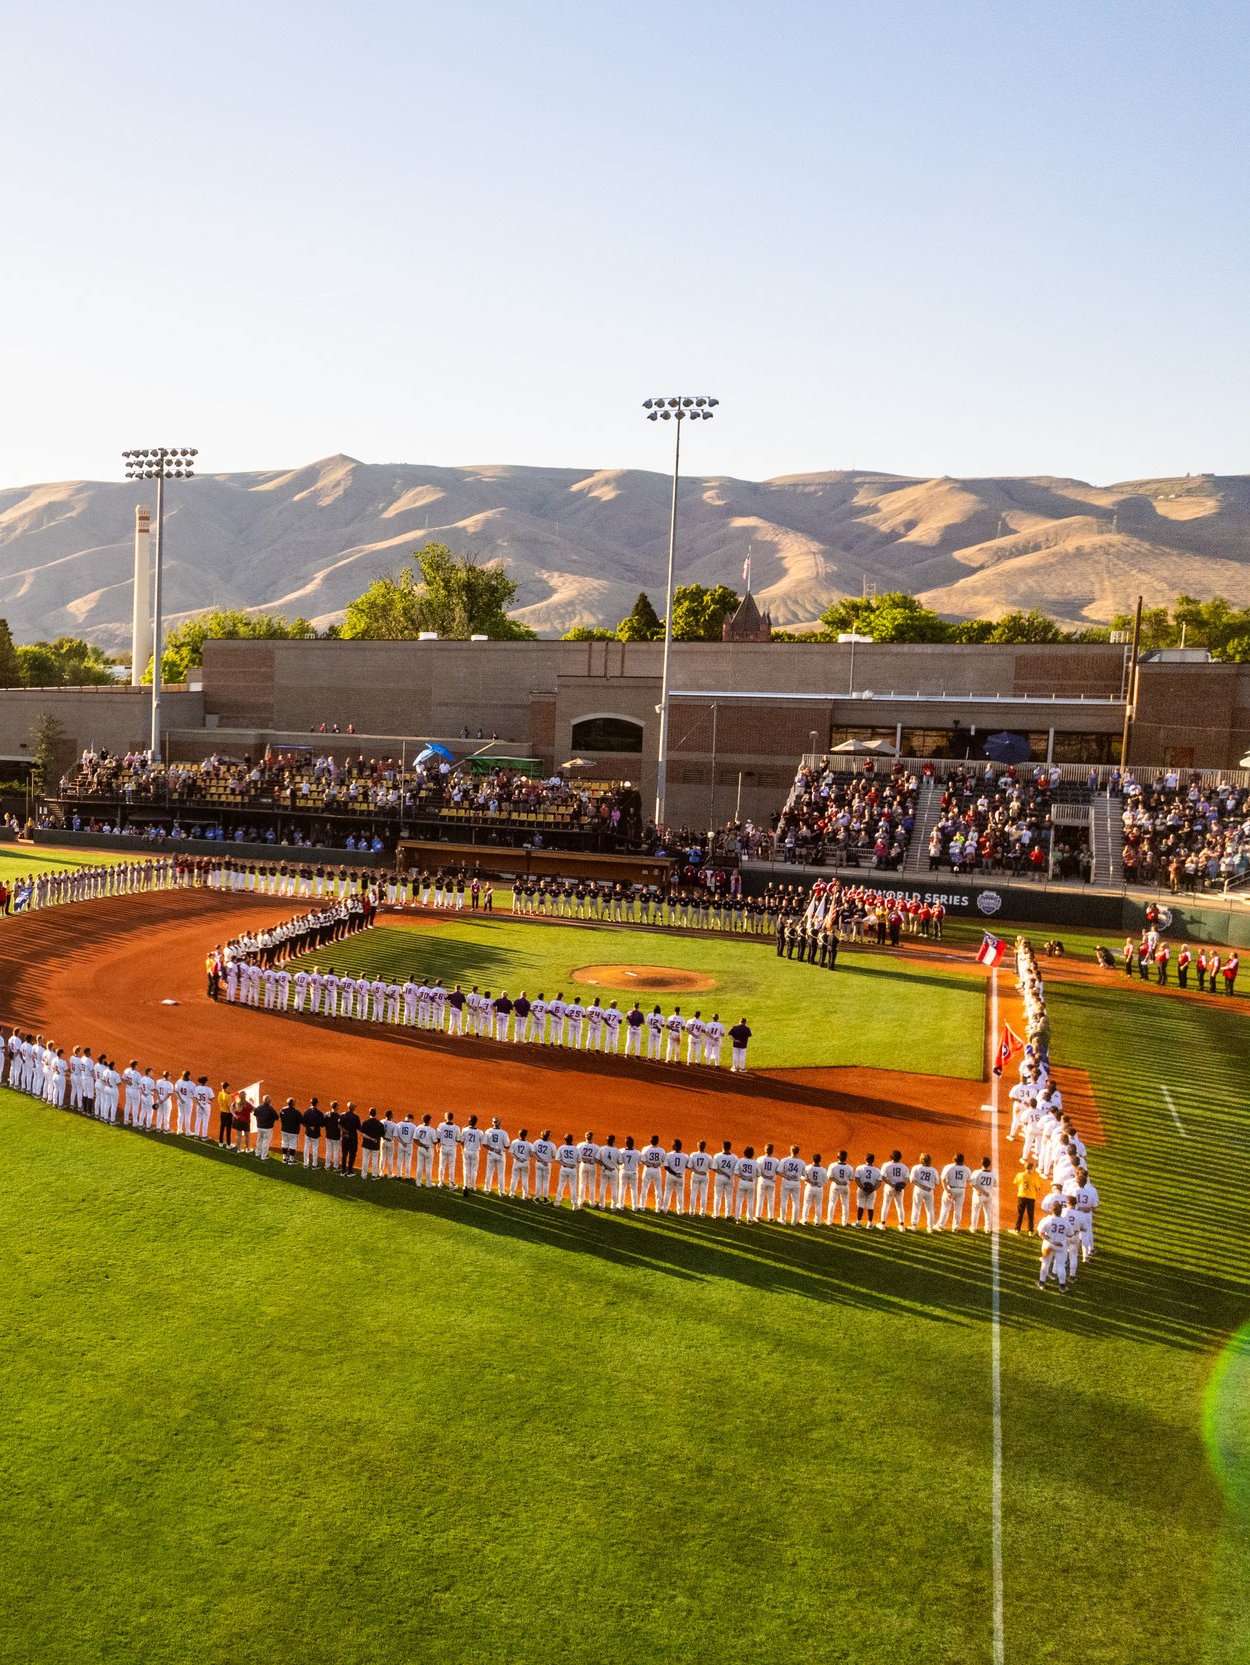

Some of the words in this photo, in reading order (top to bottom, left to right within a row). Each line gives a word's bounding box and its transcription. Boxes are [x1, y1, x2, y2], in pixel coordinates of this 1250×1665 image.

[923, 892, 969, 907] SERIES
[533, 1004, 544, 1013] 23
[569, 1010, 581, 1018] 25
[589, 1010, 600, 1019] 24
[444, 1129, 454, 1139] 36
[468, 1133, 476, 1143] 21
[517, 1145, 525, 1154] 12
[537, 1144, 548, 1155] 32
[563, 1149, 574, 1160] 35
[582, 1147, 593, 1157] 22
[626, 1155, 632, 1164] 7
[649, 1152, 659, 1162] 38
[696, 1157, 705, 1167] 17
[721, 1159, 731, 1170] 24
[742, 1163, 753, 1174] 39
[788, 1162, 799, 1174] 34
[812, 1171, 818, 1181] 6
[839, 1168, 845, 1178] 9
[866, 1169, 872, 1179] 3
[892, 1167, 901, 1177] 18
[920, 1170, 931, 1182] 28
[955, 1170, 964, 1181] 15
[980, 1175, 991, 1186] 20
[1023, 1181, 1029, 1190] 3
[1077, 1194, 1089, 1204] 13
[1069, 1216, 1075, 1226] 2
[1051, 1223, 1066, 1234] 32
